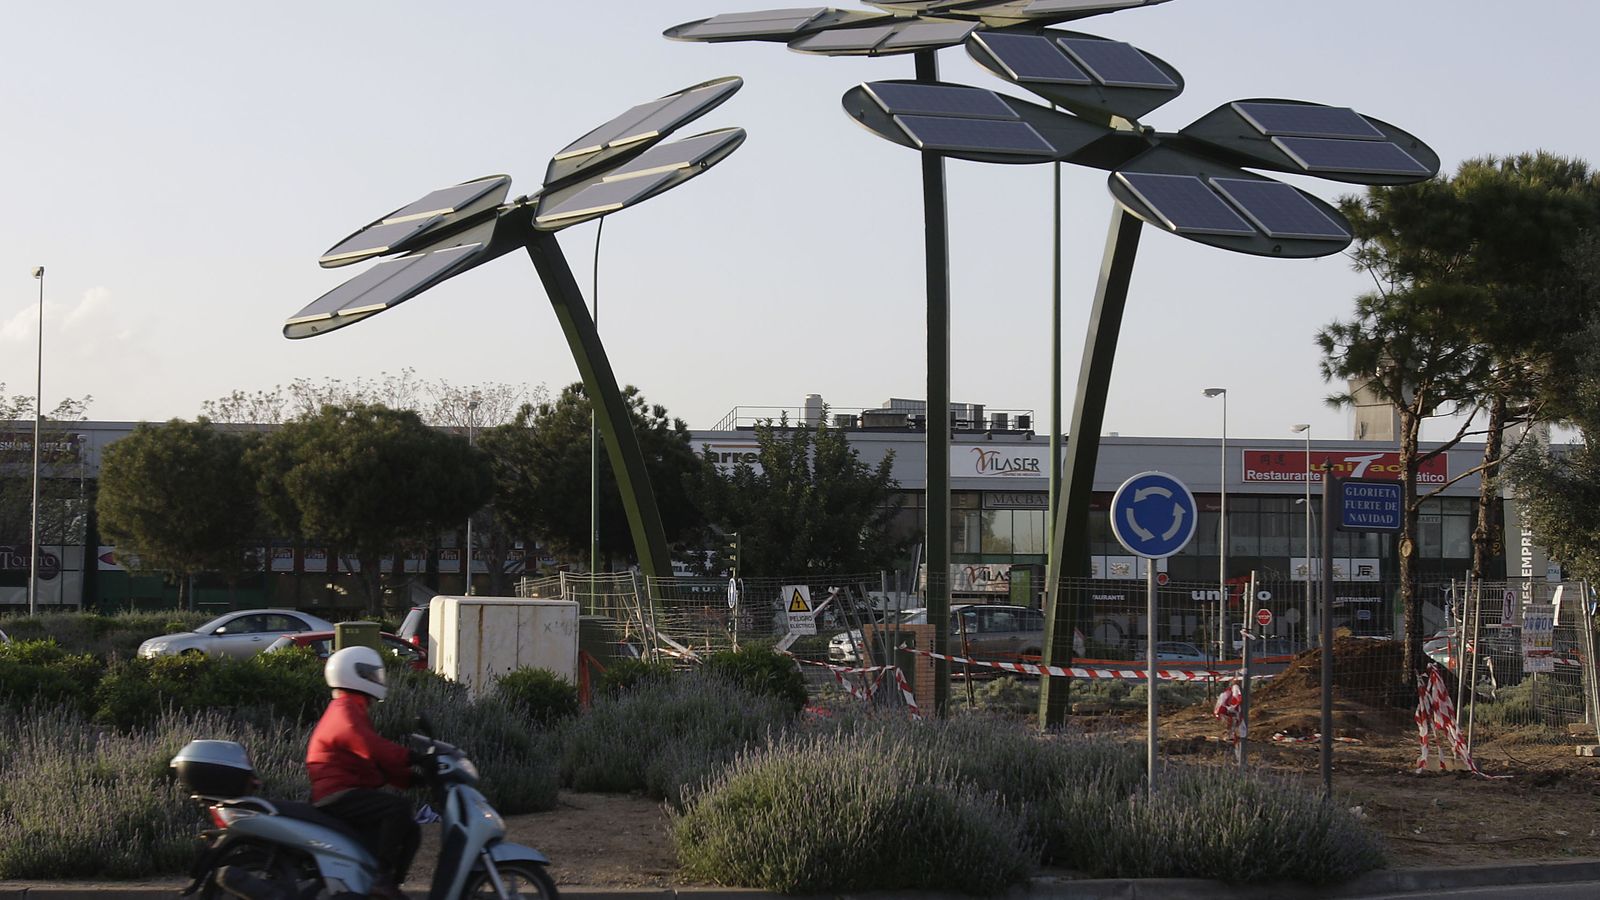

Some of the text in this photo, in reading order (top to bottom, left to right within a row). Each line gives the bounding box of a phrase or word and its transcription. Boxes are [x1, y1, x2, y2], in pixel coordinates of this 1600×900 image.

[970, 447, 1041, 475] VILASER
[1247, 469, 1321, 481] Restaurante
[1345, 486, 1397, 499] GLORIETA
[1345, 499, 1397, 511] FUERTE DE
[1349, 513, 1394, 524] NAVIDAD
